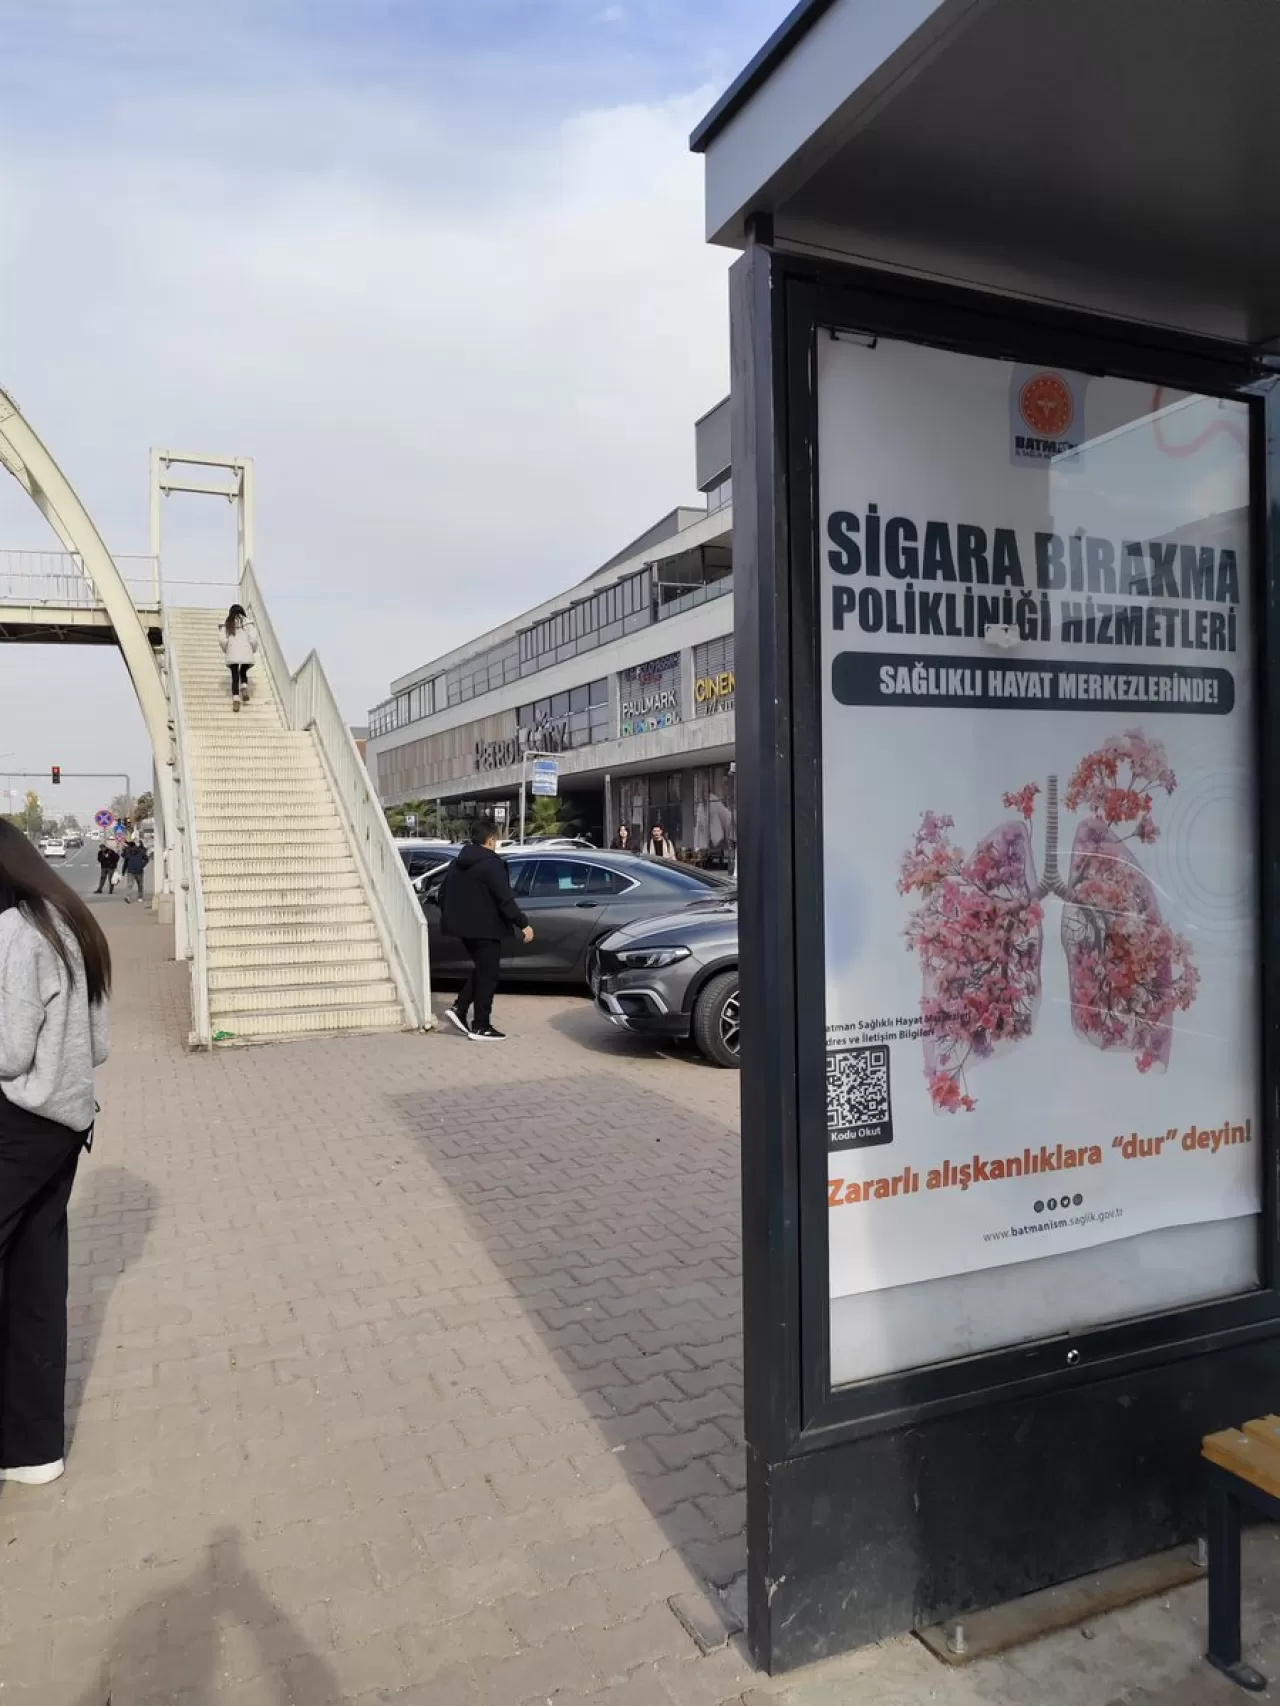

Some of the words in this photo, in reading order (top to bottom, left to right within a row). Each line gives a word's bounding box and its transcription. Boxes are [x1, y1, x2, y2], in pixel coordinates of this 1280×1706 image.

[827, 503, 1025, 587] SİGARA
[832, 582, 1052, 642] POLİKLİNİĞİ
[1061, 596, 1236, 652] HİZMETLERİ
[879, 661, 982, 696] SAĞLIKLI
[988, 670, 1053, 698] HAYAT
[1058, 672, 1219, 704] MERKEZLERİNDE!
[622, 690, 677, 720] PAULMARK
[826, 1023, 856, 1033] atman
[858, 1018, 894, 1031] Sağlıklı
[895, 1015, 923, 1027] Hayat
[826, 1037, 847, 1047] dres
[849, 1036, 860, 1045] ve
[861, 1031, 897, 1043] İletişim
[831, 1130, 857, 1142] Kodu
[858, 1126, 881, 1138] Okut
[828, 1166, 919, 1207] Zararlı
[925, 1143, 1102, 1191] alışkanlıklara
[1181, 1118, 1252, 1154] deyin!
[983, 1207, 1123, 1242] www.batmanism.saglik.gov.tr
